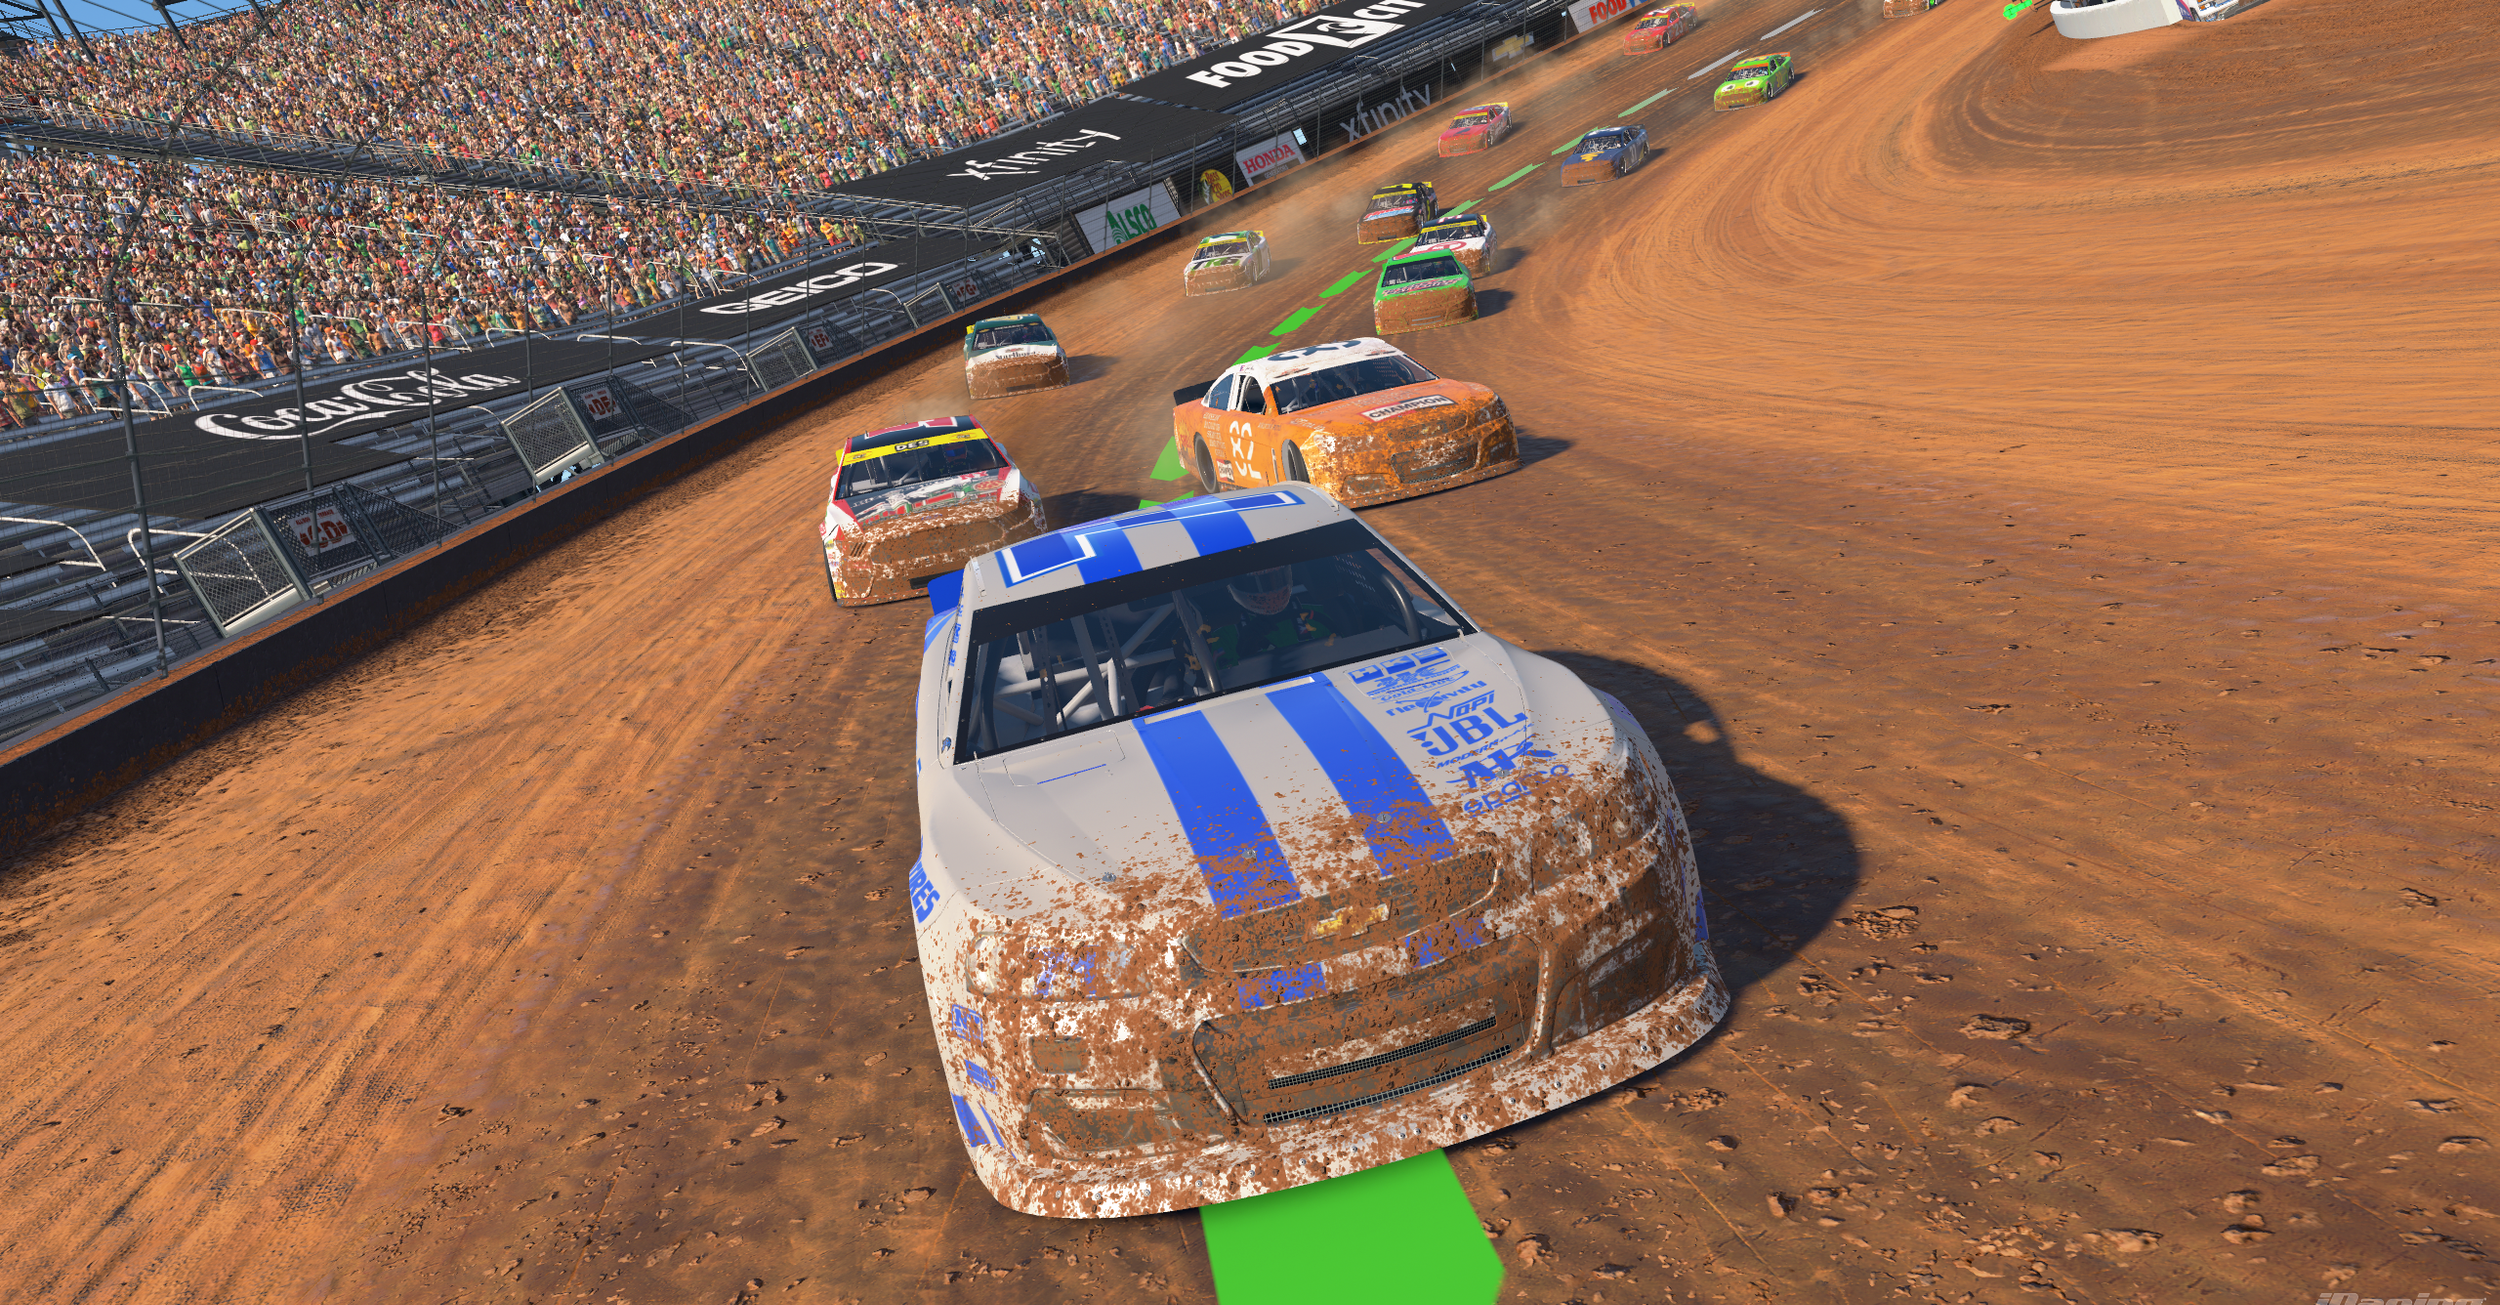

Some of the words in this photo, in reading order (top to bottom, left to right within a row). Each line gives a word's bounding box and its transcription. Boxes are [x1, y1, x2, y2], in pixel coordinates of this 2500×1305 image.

[1185, 40, 1314, 89] FOOD
[1339, 83, 1431, 142] xfinity
[946, 128, 1121, 181] xfinity
[1242, 143, 1296, 175] HONDA
[700, 261, 898, 315] GEICO
[194, 367, 521, 441] Coca-Cola
[1369, 396, 1450, 418] CHAMPION
[1426, 706, 1528, 756] JBL
[1436, 738, 1499, 770] MODERN
